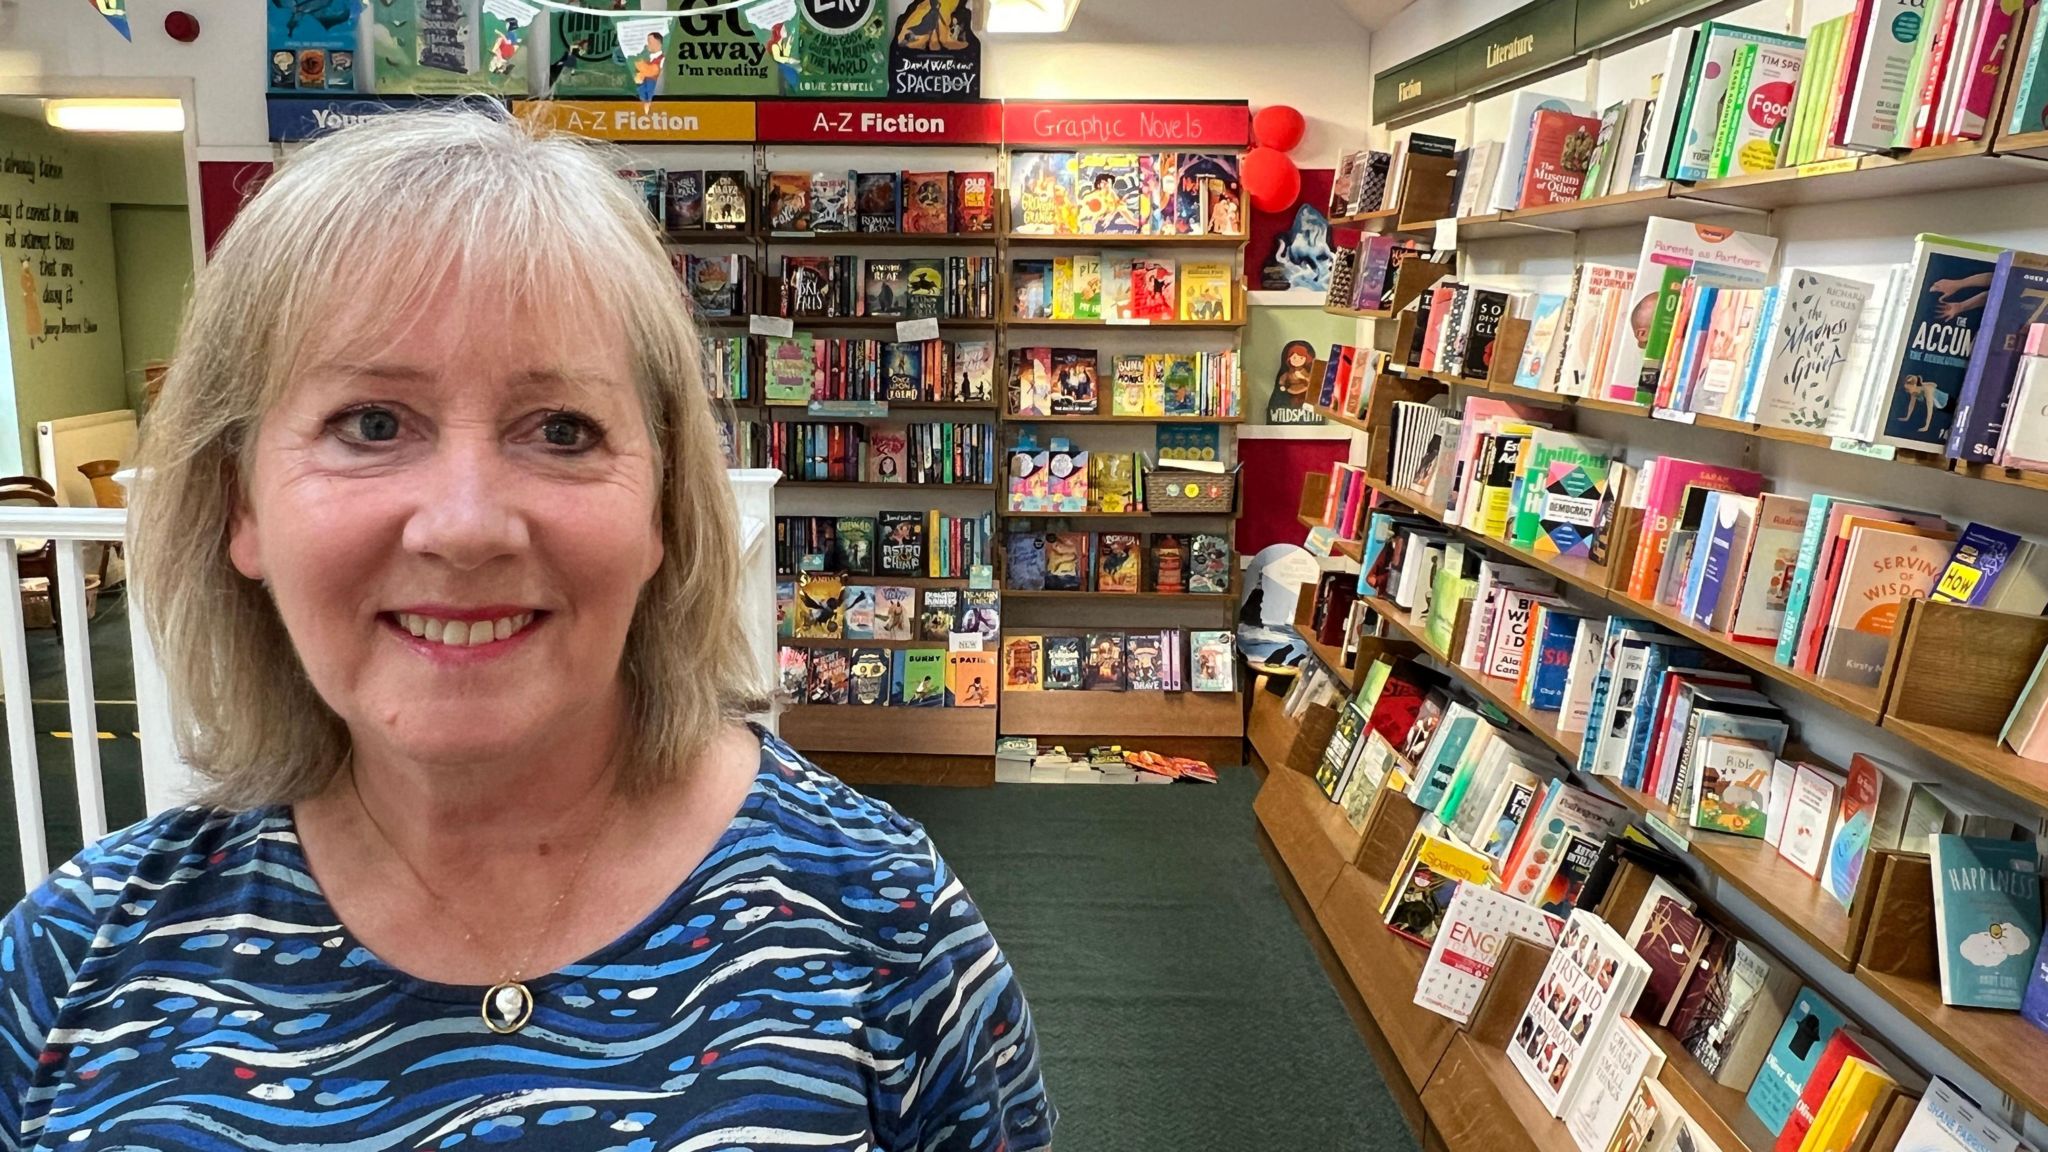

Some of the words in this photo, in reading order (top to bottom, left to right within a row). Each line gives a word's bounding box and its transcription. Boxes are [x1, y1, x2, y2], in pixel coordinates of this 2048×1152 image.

[678, 37, 767, 66] away
[1486, 33, 1534, 69] Literature
[678, 64, 704, 76] I'm
[705, 64, 769, 79] reading
[828, 58, 868, 75] WORLD
[896, 59, 929, 72] David
[1761, 54, 1779, 67] TIM
[1781, 60, 1801, 72] SPE
[800, 82, 827, 91] LOUIE
[831, 82, 874, 92] STOWELL
[896, 73, 977, 93] SPACEBOY
[1397, 79, 1422, 102] Fiction
[568, 112, 607, 131] A-Z
[614, 111, 699, 131] Fiction
[813, 112, 853, 132] A-Z
[861, 113, 945, 133] Fiction
[1034, 109, 1126, 142] Graphic
[1140, 111, 1203, 139] Novels
[1763, 114, 1776, 125] for
[1541, 162, 1555, 171] The
[1533, 167, 1579, 186] Museum
[1536, 182, 1546, 190] of
[1547, 180, 1577, 196] Other
[1654, 240, 1694, 256] Parents
[1714, 250, 1761, 268] Partners
[1592, 267, 1611, 277] HOW
[1827, 288, 1866, 300] RICHARD
[1777, 314, 1847, 359] Madness
[1119, 360, 1143, 371] BUNN
[1791, 344, 1847, 395] Grief
[1118, 374, 1143, 383] MONKE
[1548, 501, 1593, 516] DEMOCRACY
[1900, 572, 1914, 580] OF
[1863, 583, 1925, 601] WISDO
[958, 640, 977, 649] NEW
[1496, 664, 1519, 675] Cam
[1501, 655, 1521, 665] Ala
[1726, 756, 1755, 770] Bible
[1423, 850, 1472, 880] Spanish
[1948, 867, 2035, 900] HAPPINESS
[1551, 949, 1583, 988] FIRST
[1577, 981, 1602, 1011] AID
[1530, 997, 1581, 1061] HANDBOOK
[1613, 1031, 1640, 1063] GREAT
[1608, 1042, 1632, 1075] MINDS
[1766, 1053, 1785, 1079] Oliver
[1601, 1056, 1624, 1091] SMALL
[1927, 1101, 1956, 1131] SHANE
